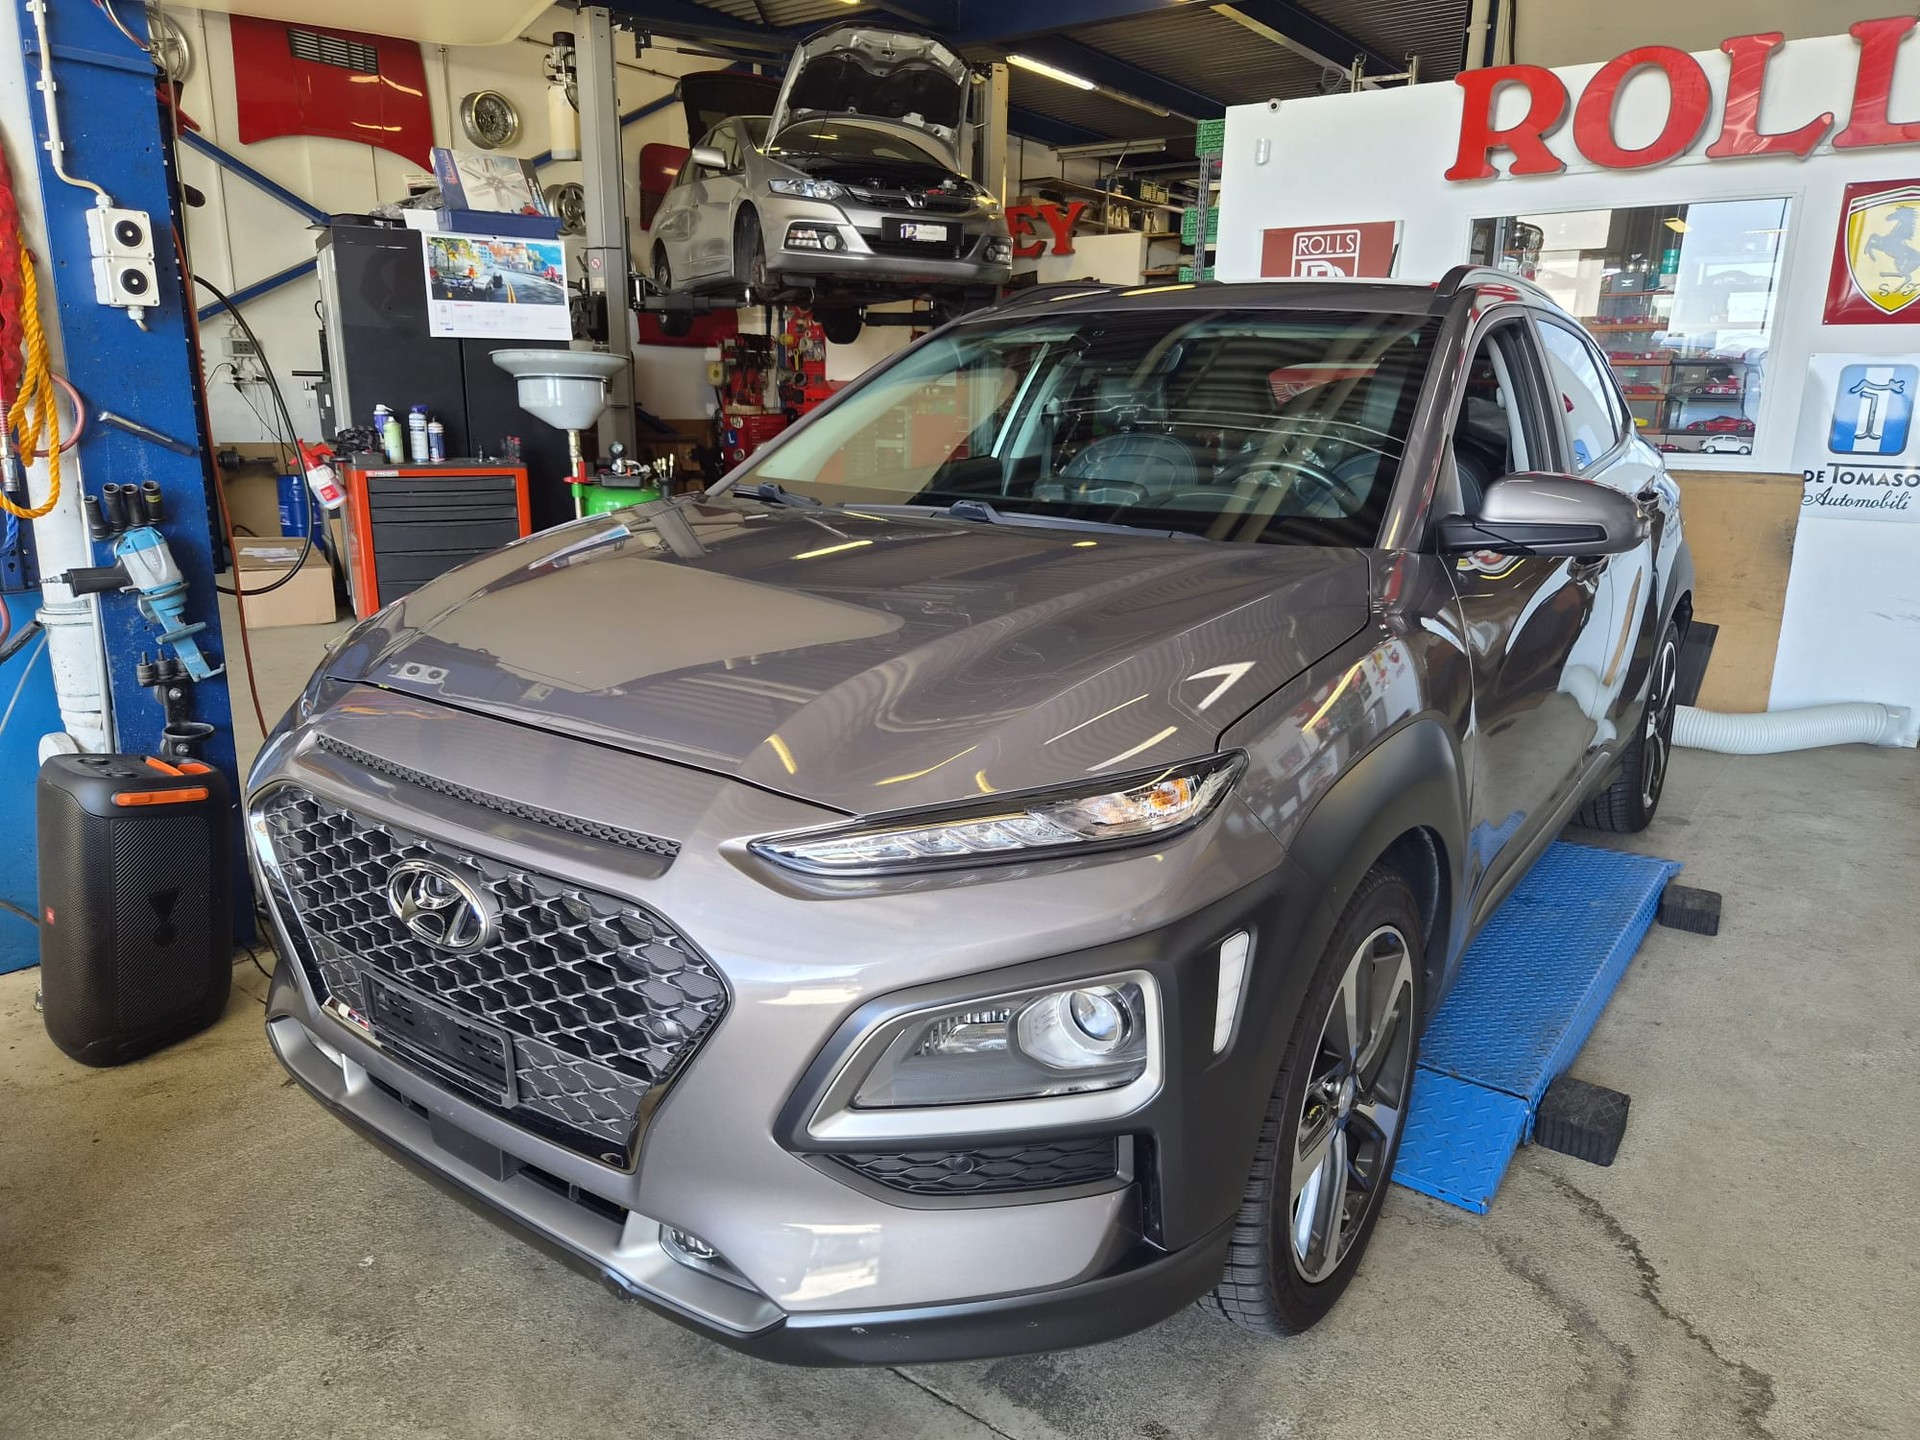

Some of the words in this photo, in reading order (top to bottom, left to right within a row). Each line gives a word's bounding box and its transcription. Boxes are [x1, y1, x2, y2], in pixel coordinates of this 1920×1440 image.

[1444, 16, 1920, 181] ROLL
[1298, 234, 1355, 255] ROLLS
[1803, 469, 1826, 484] DE
[1827, 463, 1920, 488] TOMASO
[1801, 486, 1912, 510] Automobili
